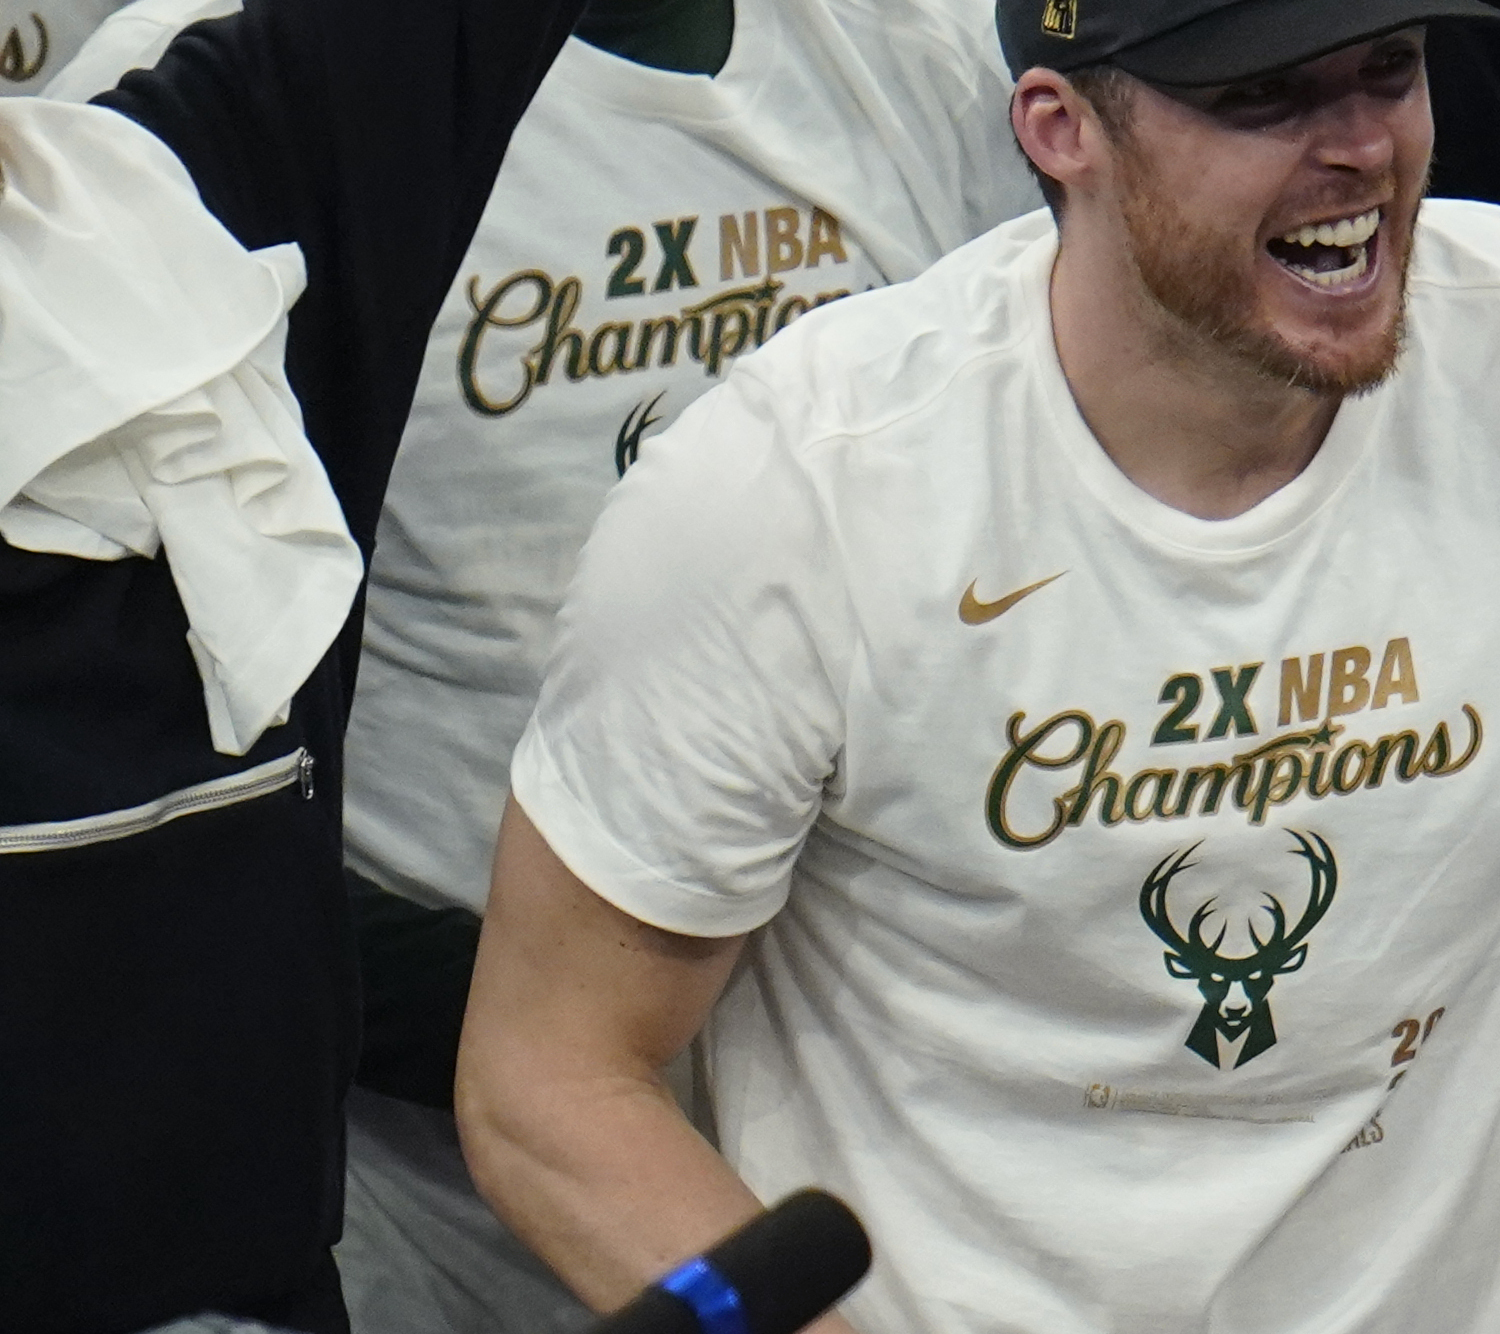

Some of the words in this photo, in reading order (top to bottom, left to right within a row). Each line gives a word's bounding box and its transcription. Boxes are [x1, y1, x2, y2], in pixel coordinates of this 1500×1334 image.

[605, 214, 700, 299] 2X
[719, 206, 849, 282] NBA
[455, 268, 851, 417] Champio
[1149, 660, 1265, 748] 2X
[1277, 636, 1421, 726] NBA
[984, 703, 1484, 852] Champions
